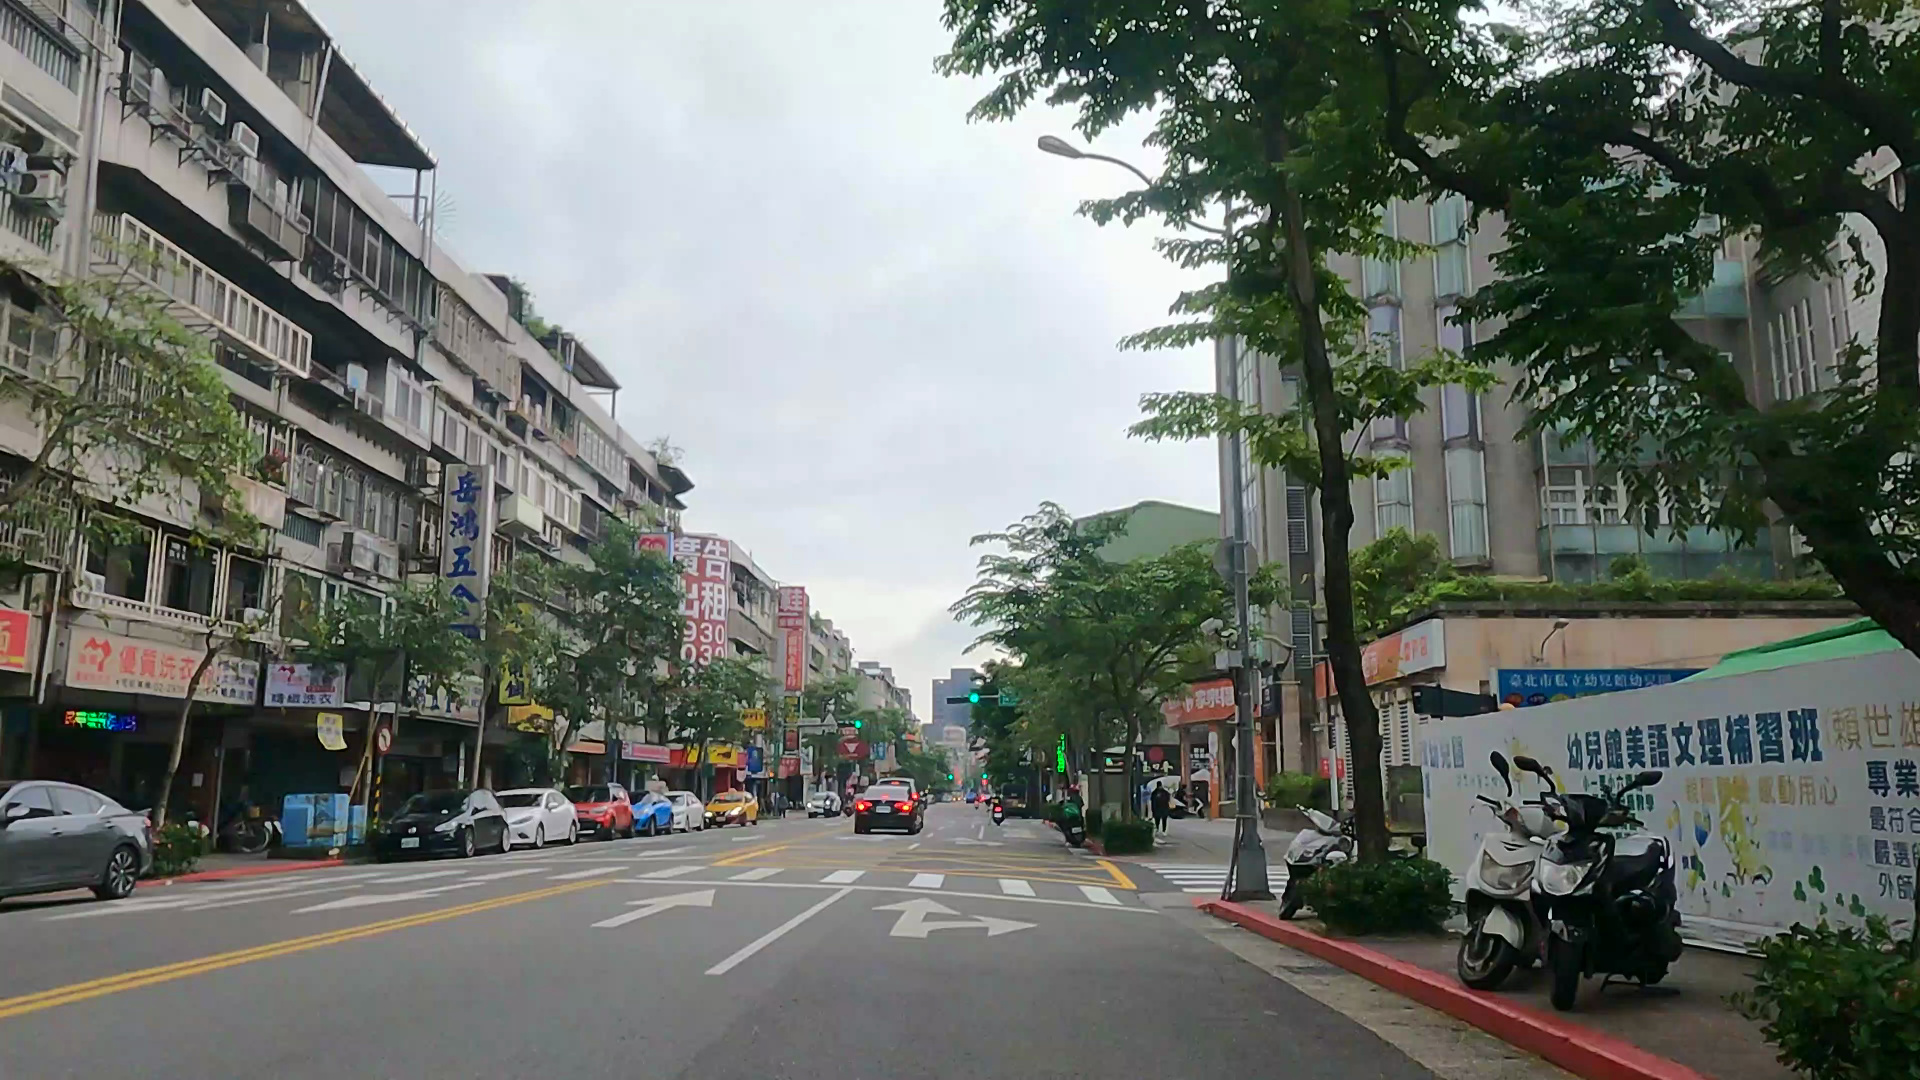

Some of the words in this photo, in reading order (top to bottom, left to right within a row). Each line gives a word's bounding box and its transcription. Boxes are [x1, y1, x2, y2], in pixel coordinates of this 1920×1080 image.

[1567, 708, 1823, 771] 幼兒館美語文理補習班
[1866, 758, 1920, 798] 專業
[1870, 805, 1920, 835] 最符合
